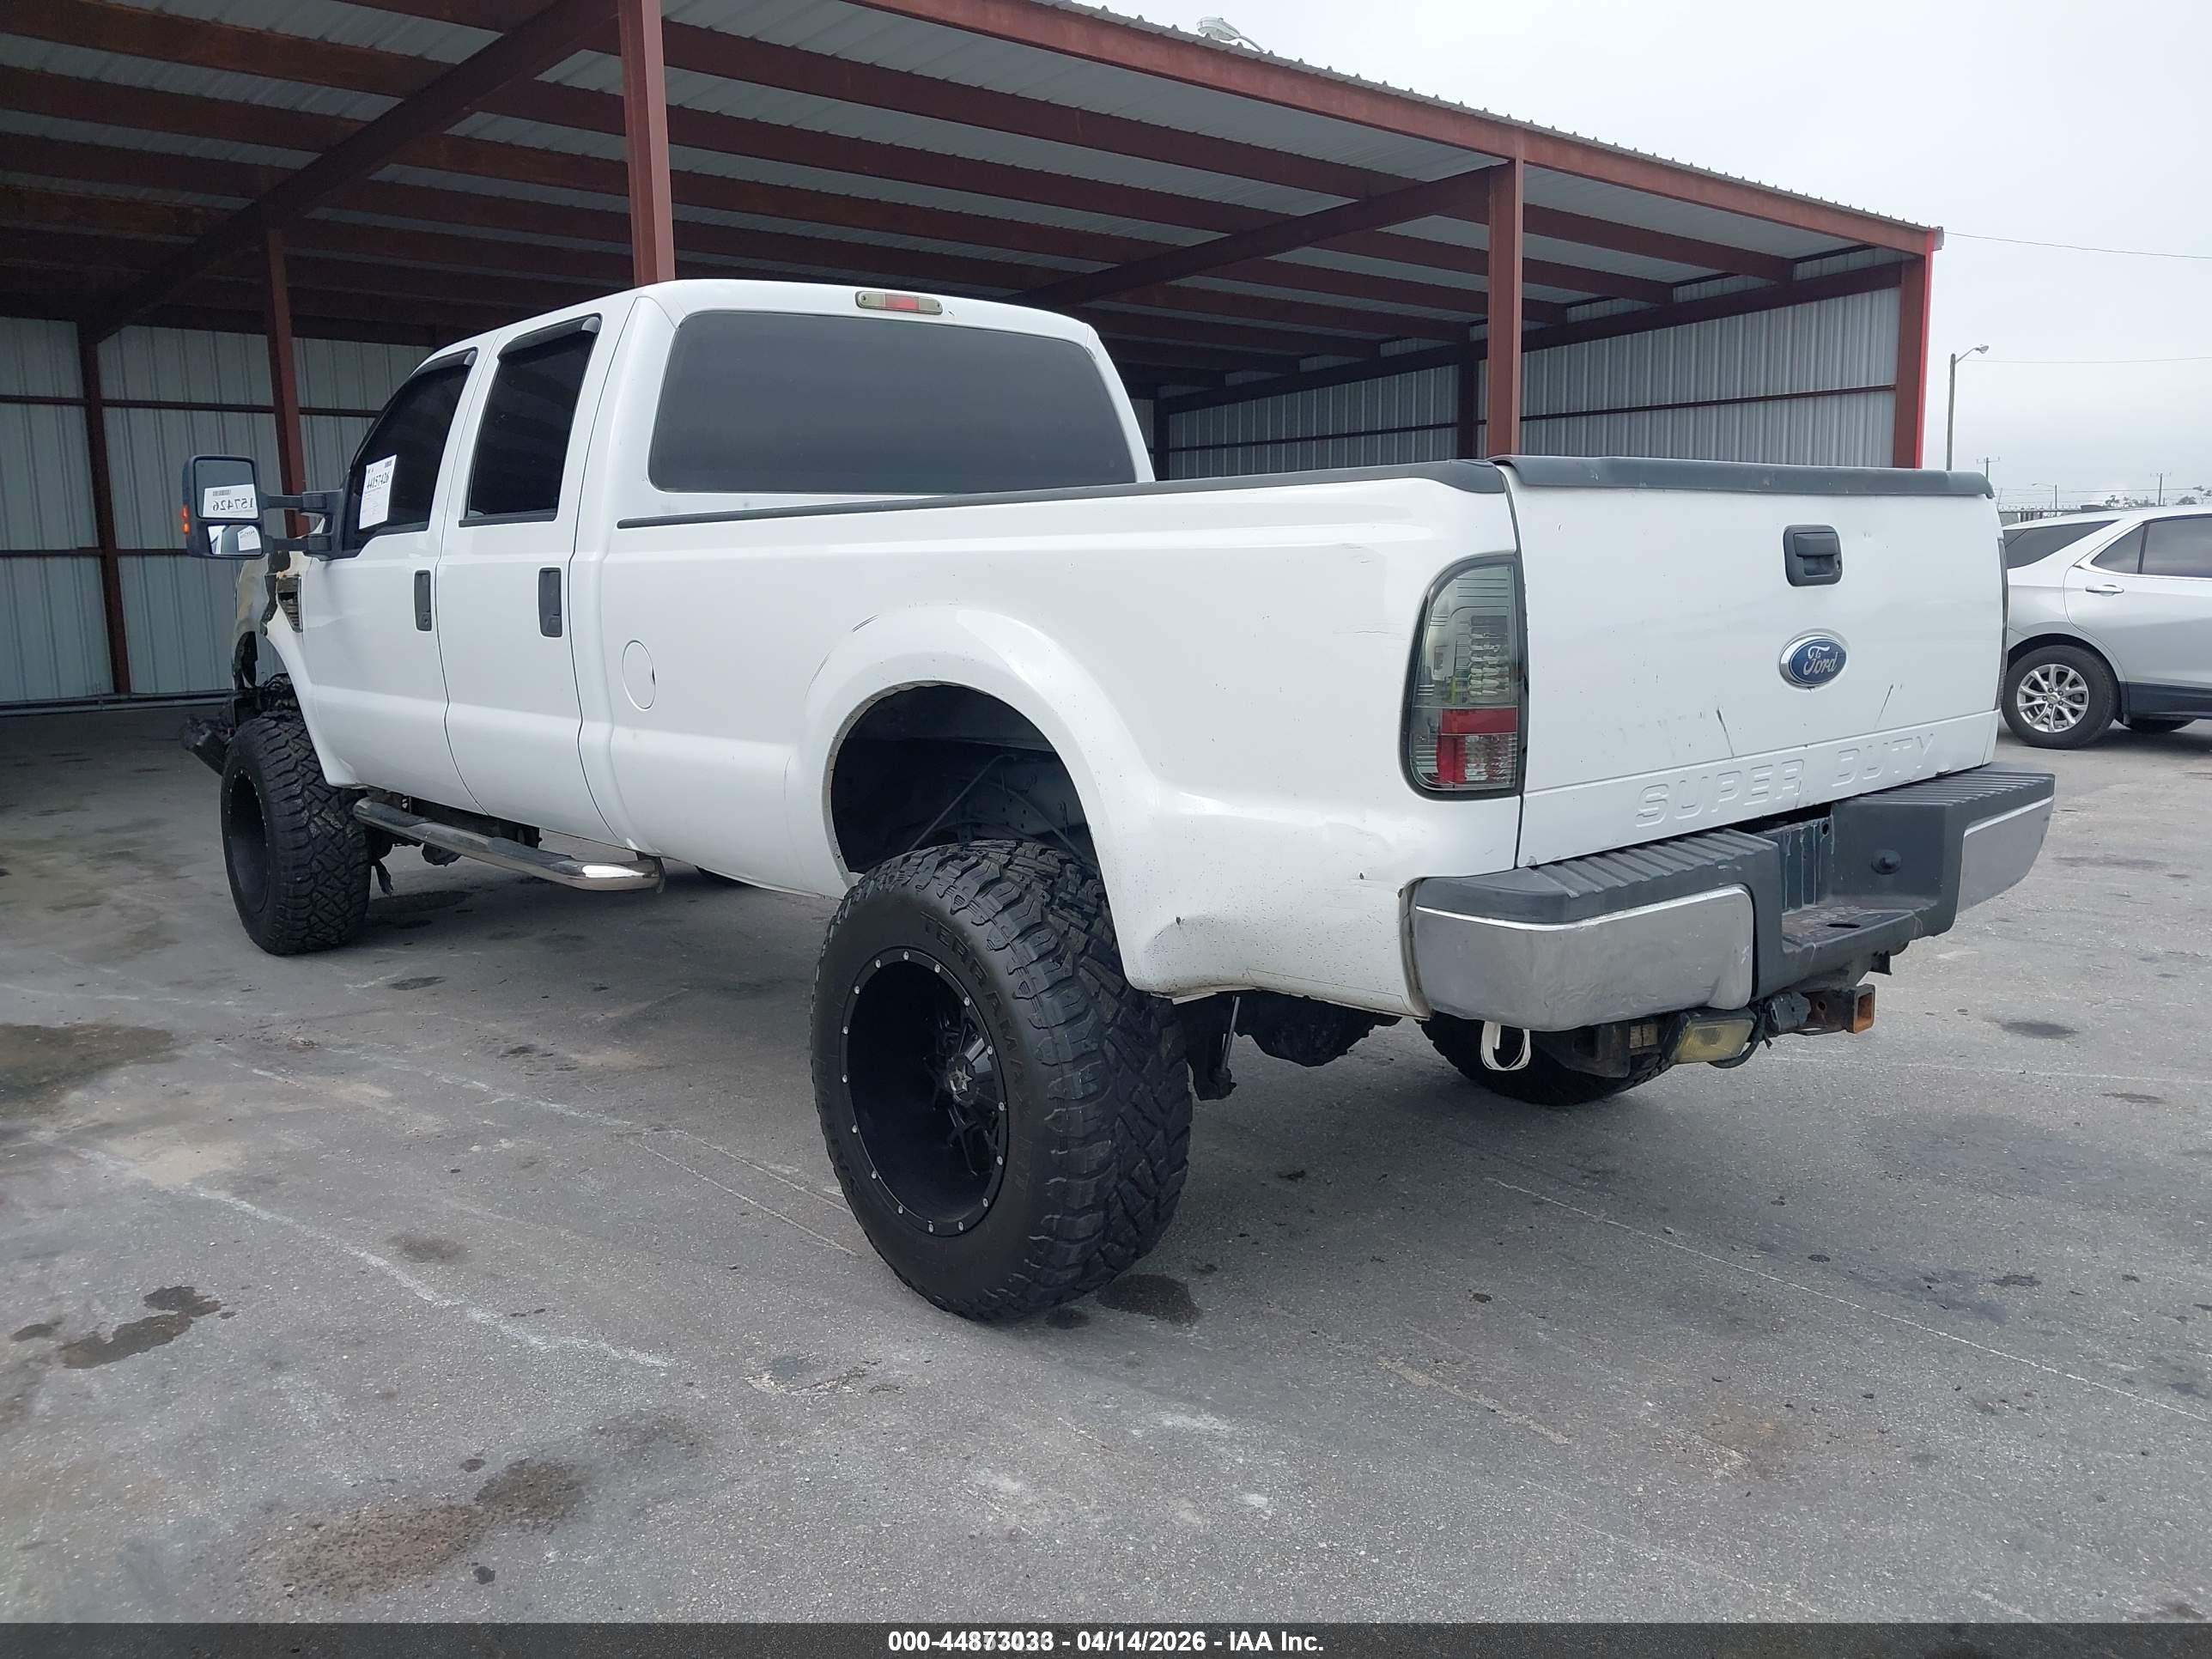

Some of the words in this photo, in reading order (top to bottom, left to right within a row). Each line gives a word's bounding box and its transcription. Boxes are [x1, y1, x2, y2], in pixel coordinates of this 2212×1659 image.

[1803, 646, 1838, 676] Ford
[1635, 758, 1805, 828] SUPER
[1831, 732, 1935, 788] DUTY
